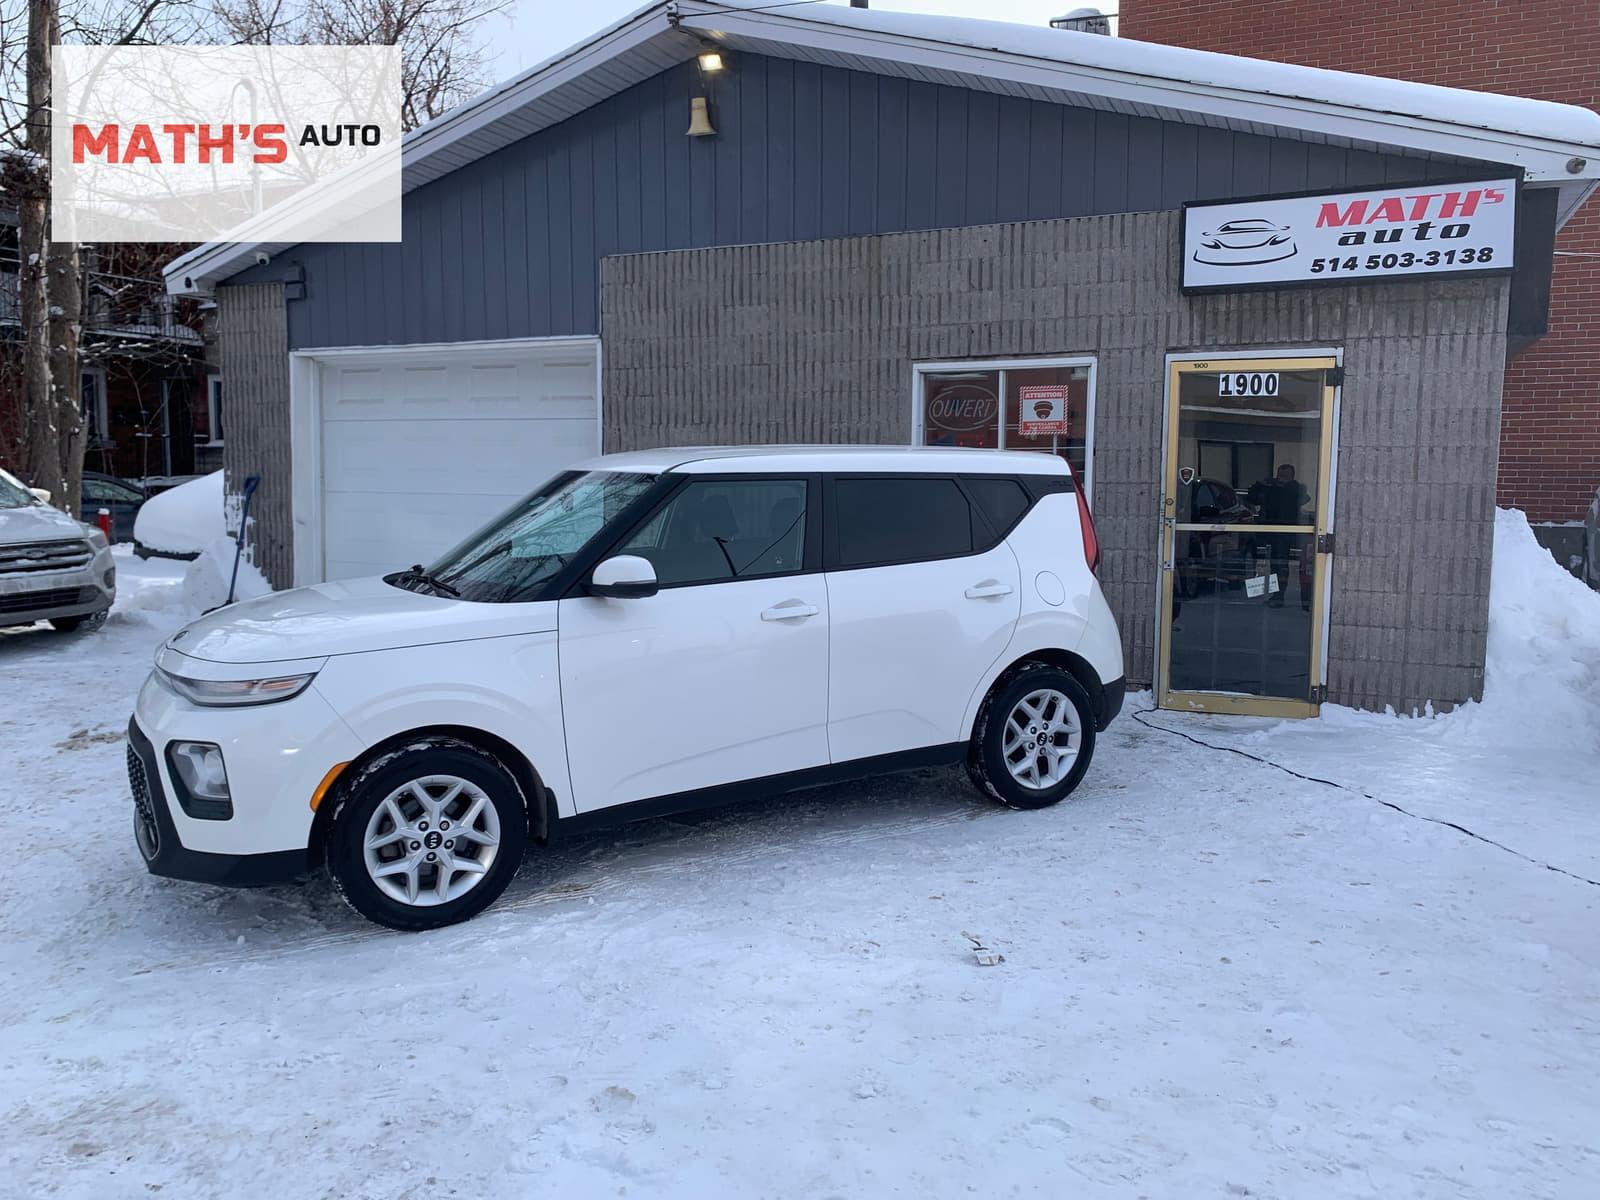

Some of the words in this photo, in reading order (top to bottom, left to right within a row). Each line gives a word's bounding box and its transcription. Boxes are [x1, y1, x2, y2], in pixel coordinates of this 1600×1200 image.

[1338, 221, 1471, 247] auto
[1310, 256, 1358, 273] 514
[1365, 247, 1494, 270] 503-3138
[1024, 391, 1063, 399] ATTENTION
[1220, 374, 1277, 395] 1900
[932, 399, 993, 418] OUVERT
